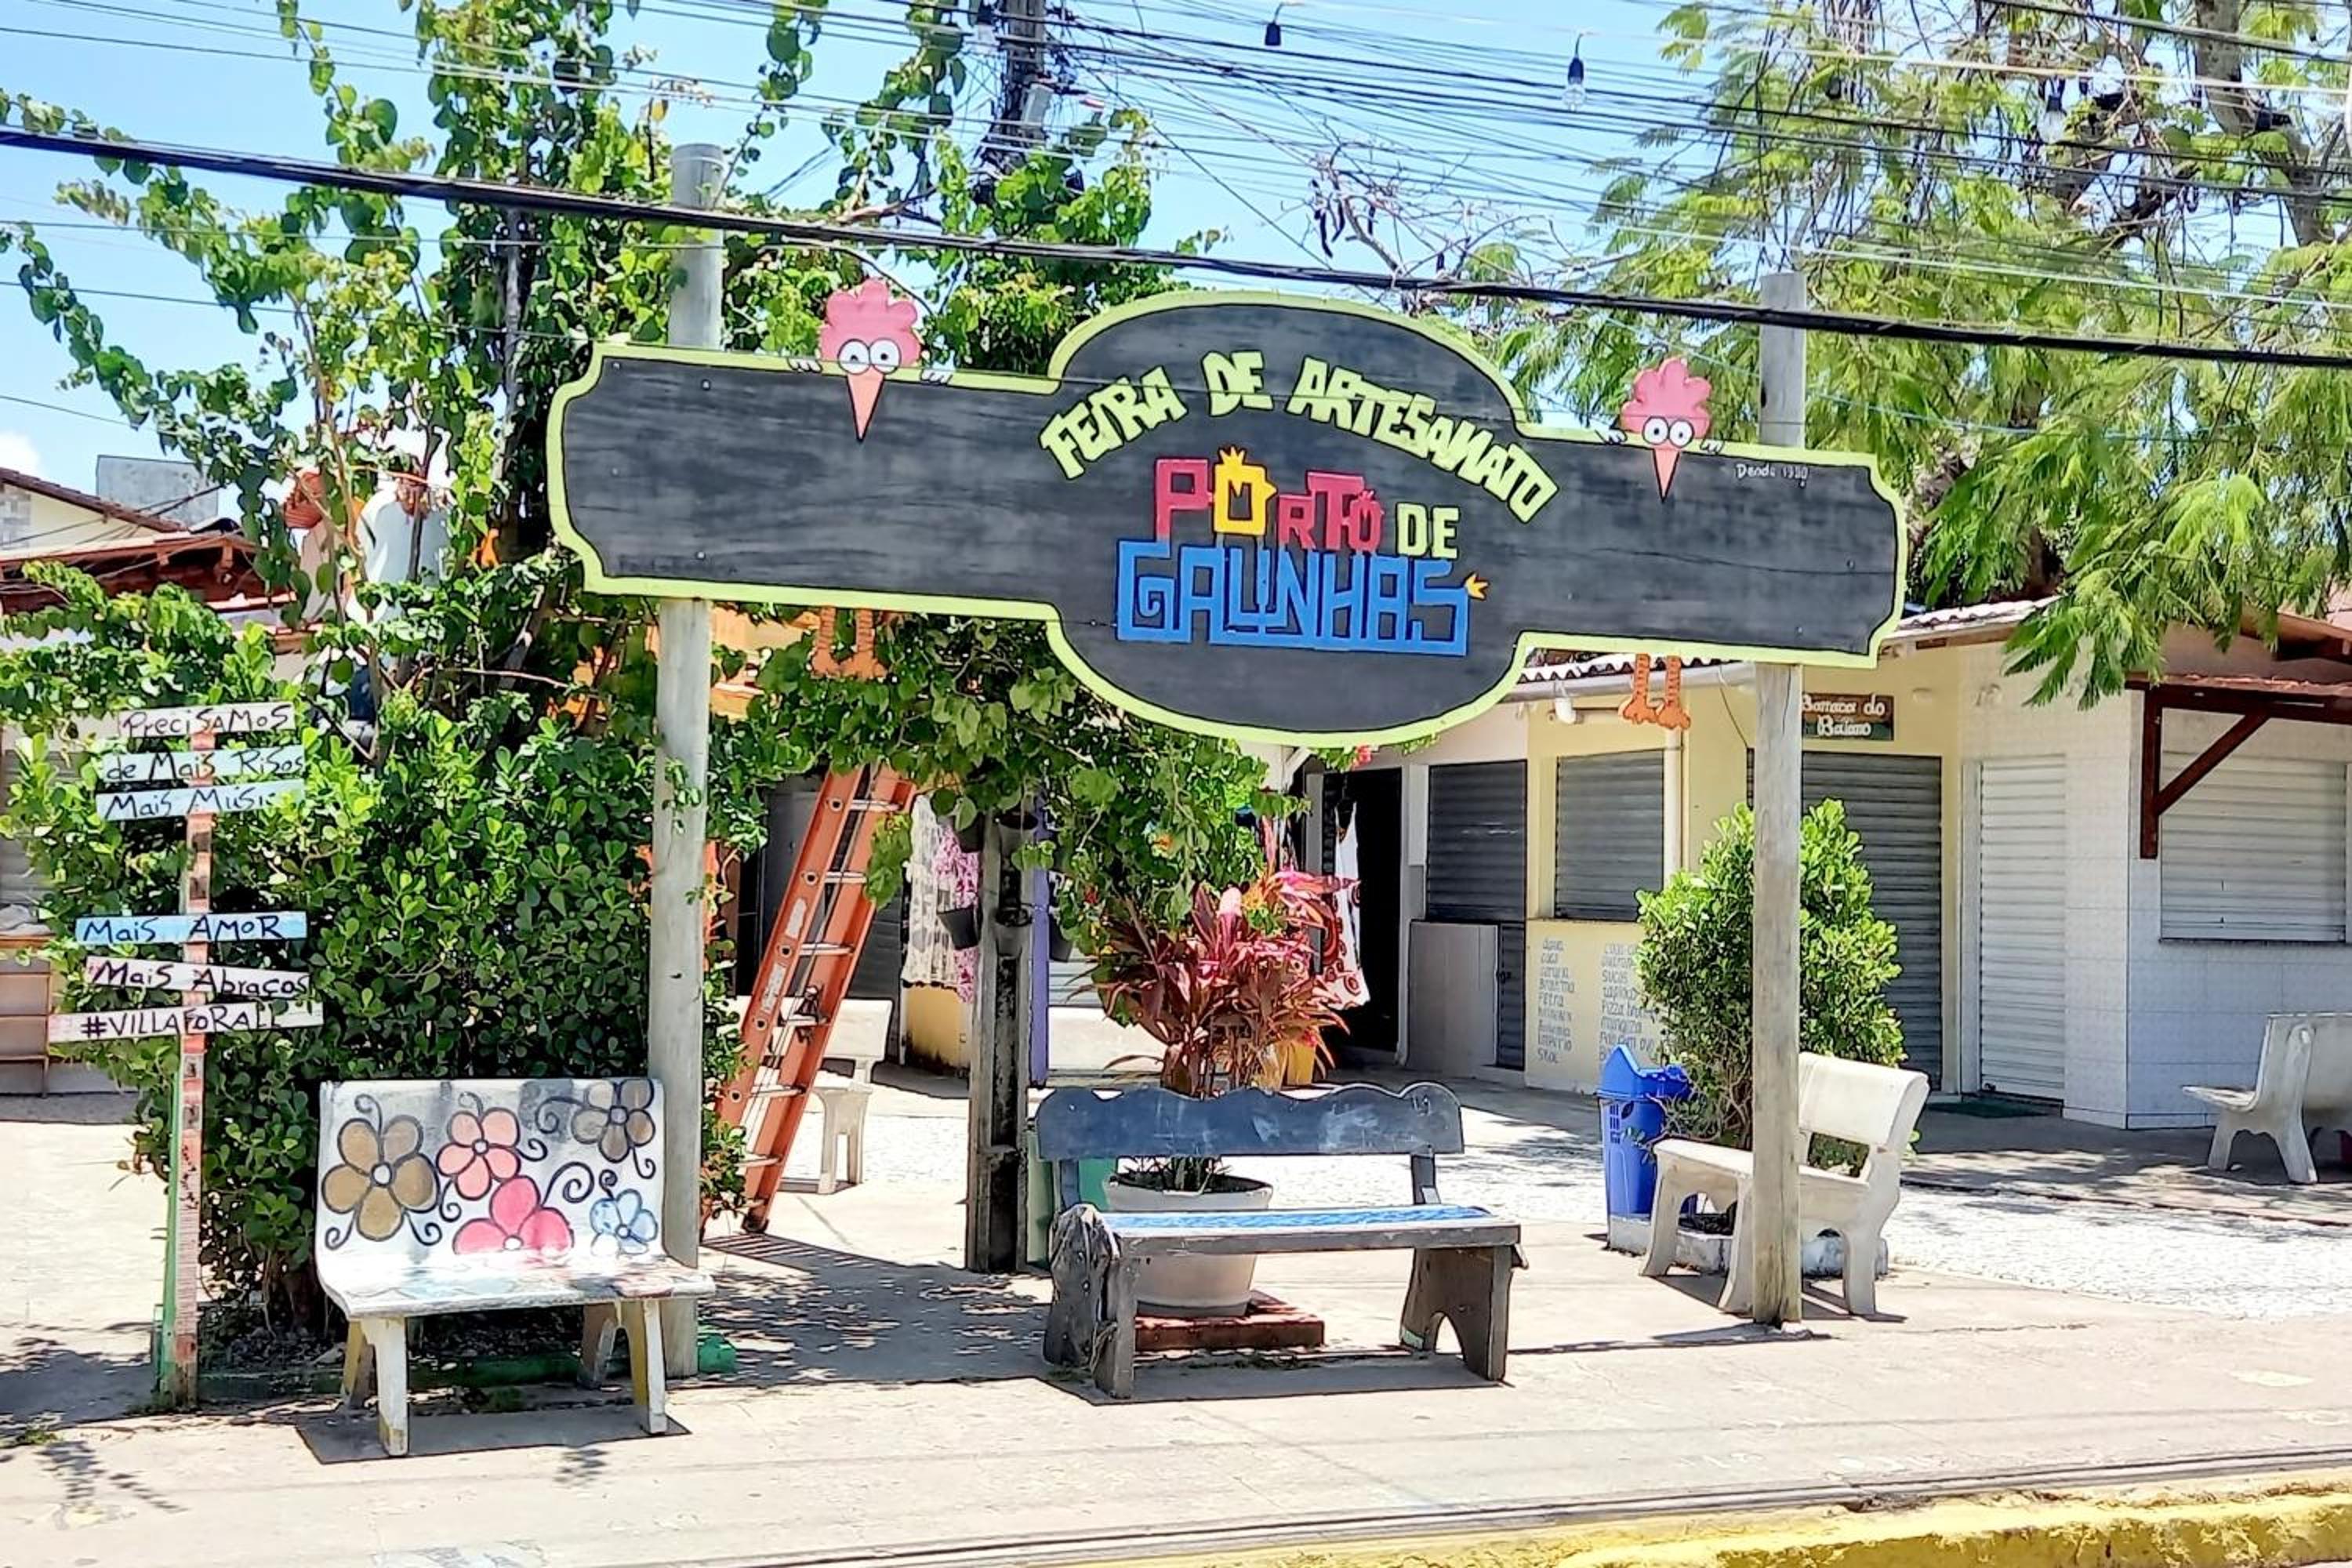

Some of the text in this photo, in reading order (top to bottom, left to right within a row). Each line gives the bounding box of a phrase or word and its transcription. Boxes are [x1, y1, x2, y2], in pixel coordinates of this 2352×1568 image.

[1039, 350, 1559, 524] FEIRA DE ARTESANATO
[1155, 447, 1461, 560] PORTO DE
[1115, 538, 1470, 656] GALINHAS
[1864, 693, 1886, 715] do
[107, 755, 136, 780] de
